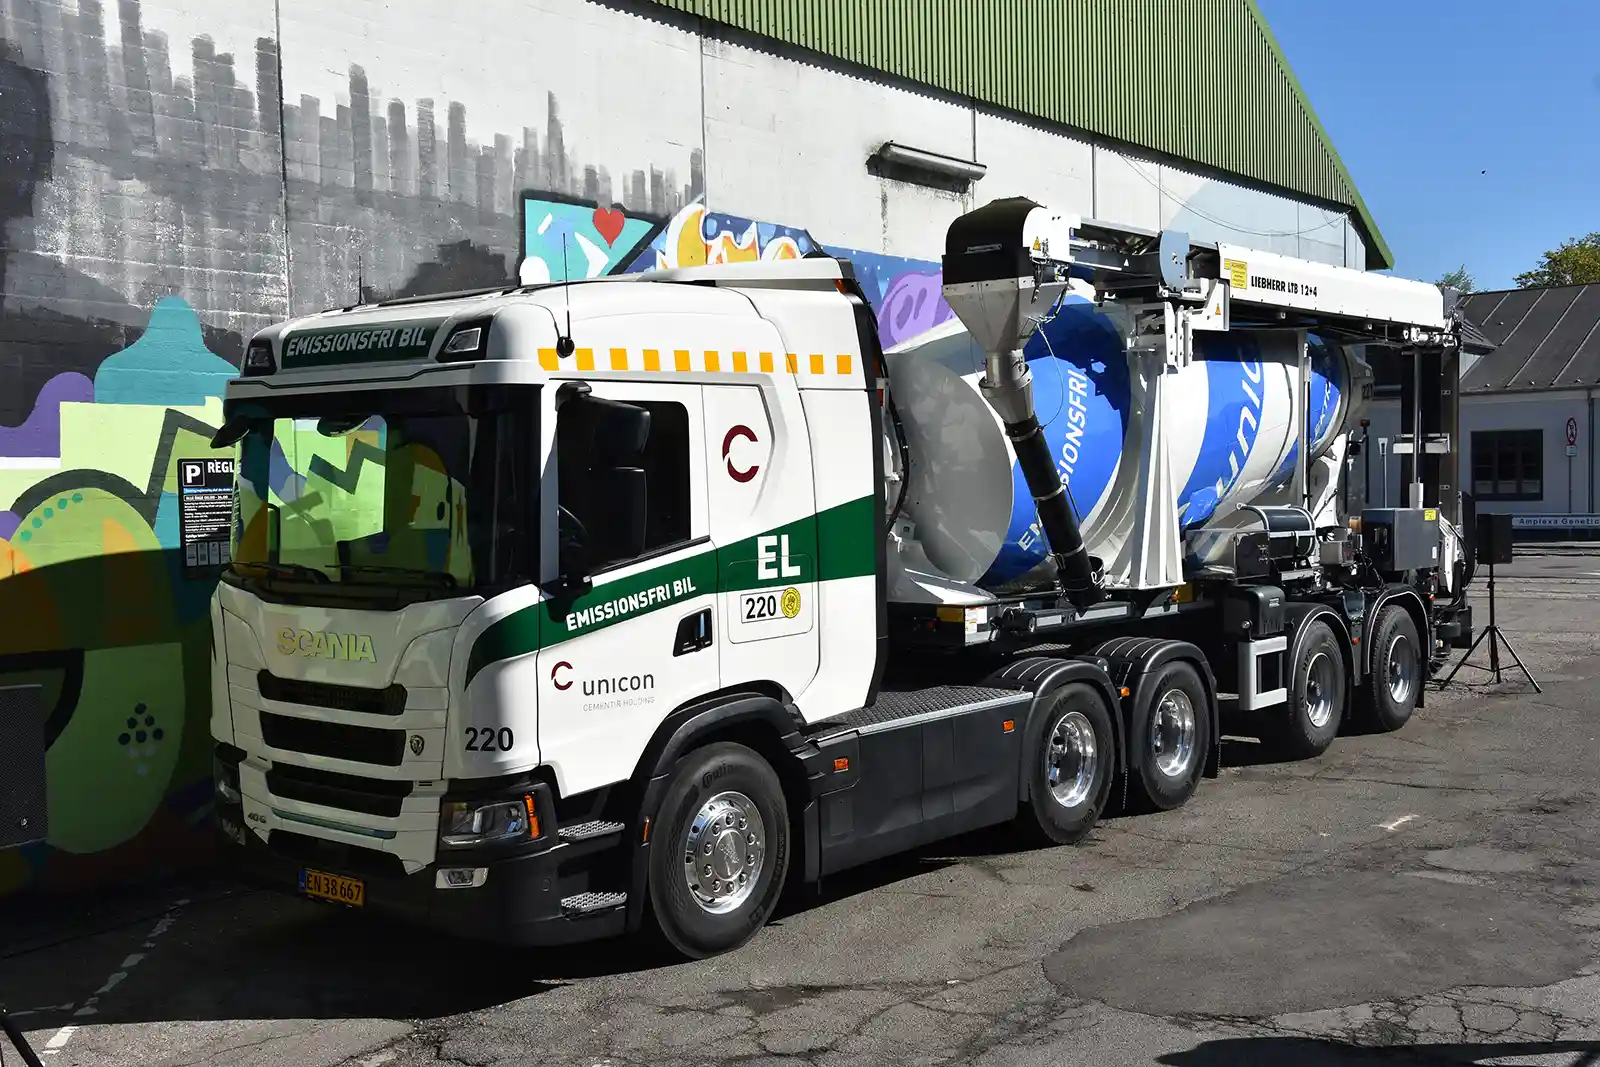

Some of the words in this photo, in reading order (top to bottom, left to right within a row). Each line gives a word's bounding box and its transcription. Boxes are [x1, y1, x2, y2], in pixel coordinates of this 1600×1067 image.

[1251, 276, 1286, 292] LIEBHERR
[1287, 281, 1298, 294] LTB
[286, 329, 396, 356] EMISSIONSFRI
[398, 326, 427, 347] BIL
[186, 465, 200, 483] P
[757, 534, 801, 580] EL
[566, 585, 671, 631] EMISSIONSFRI
[673, 577, 696, 600] BIL
[745, 595, 777, 619] 220
[277, 627, 377, 663] SCANIA
[582, 673, 655, 696] unicon
[464, 726, 515, 752] 220
[307, 873, 322, 892] EN
[323, 877, 338, 896] 38
[340, 881, 362, 901] 667
